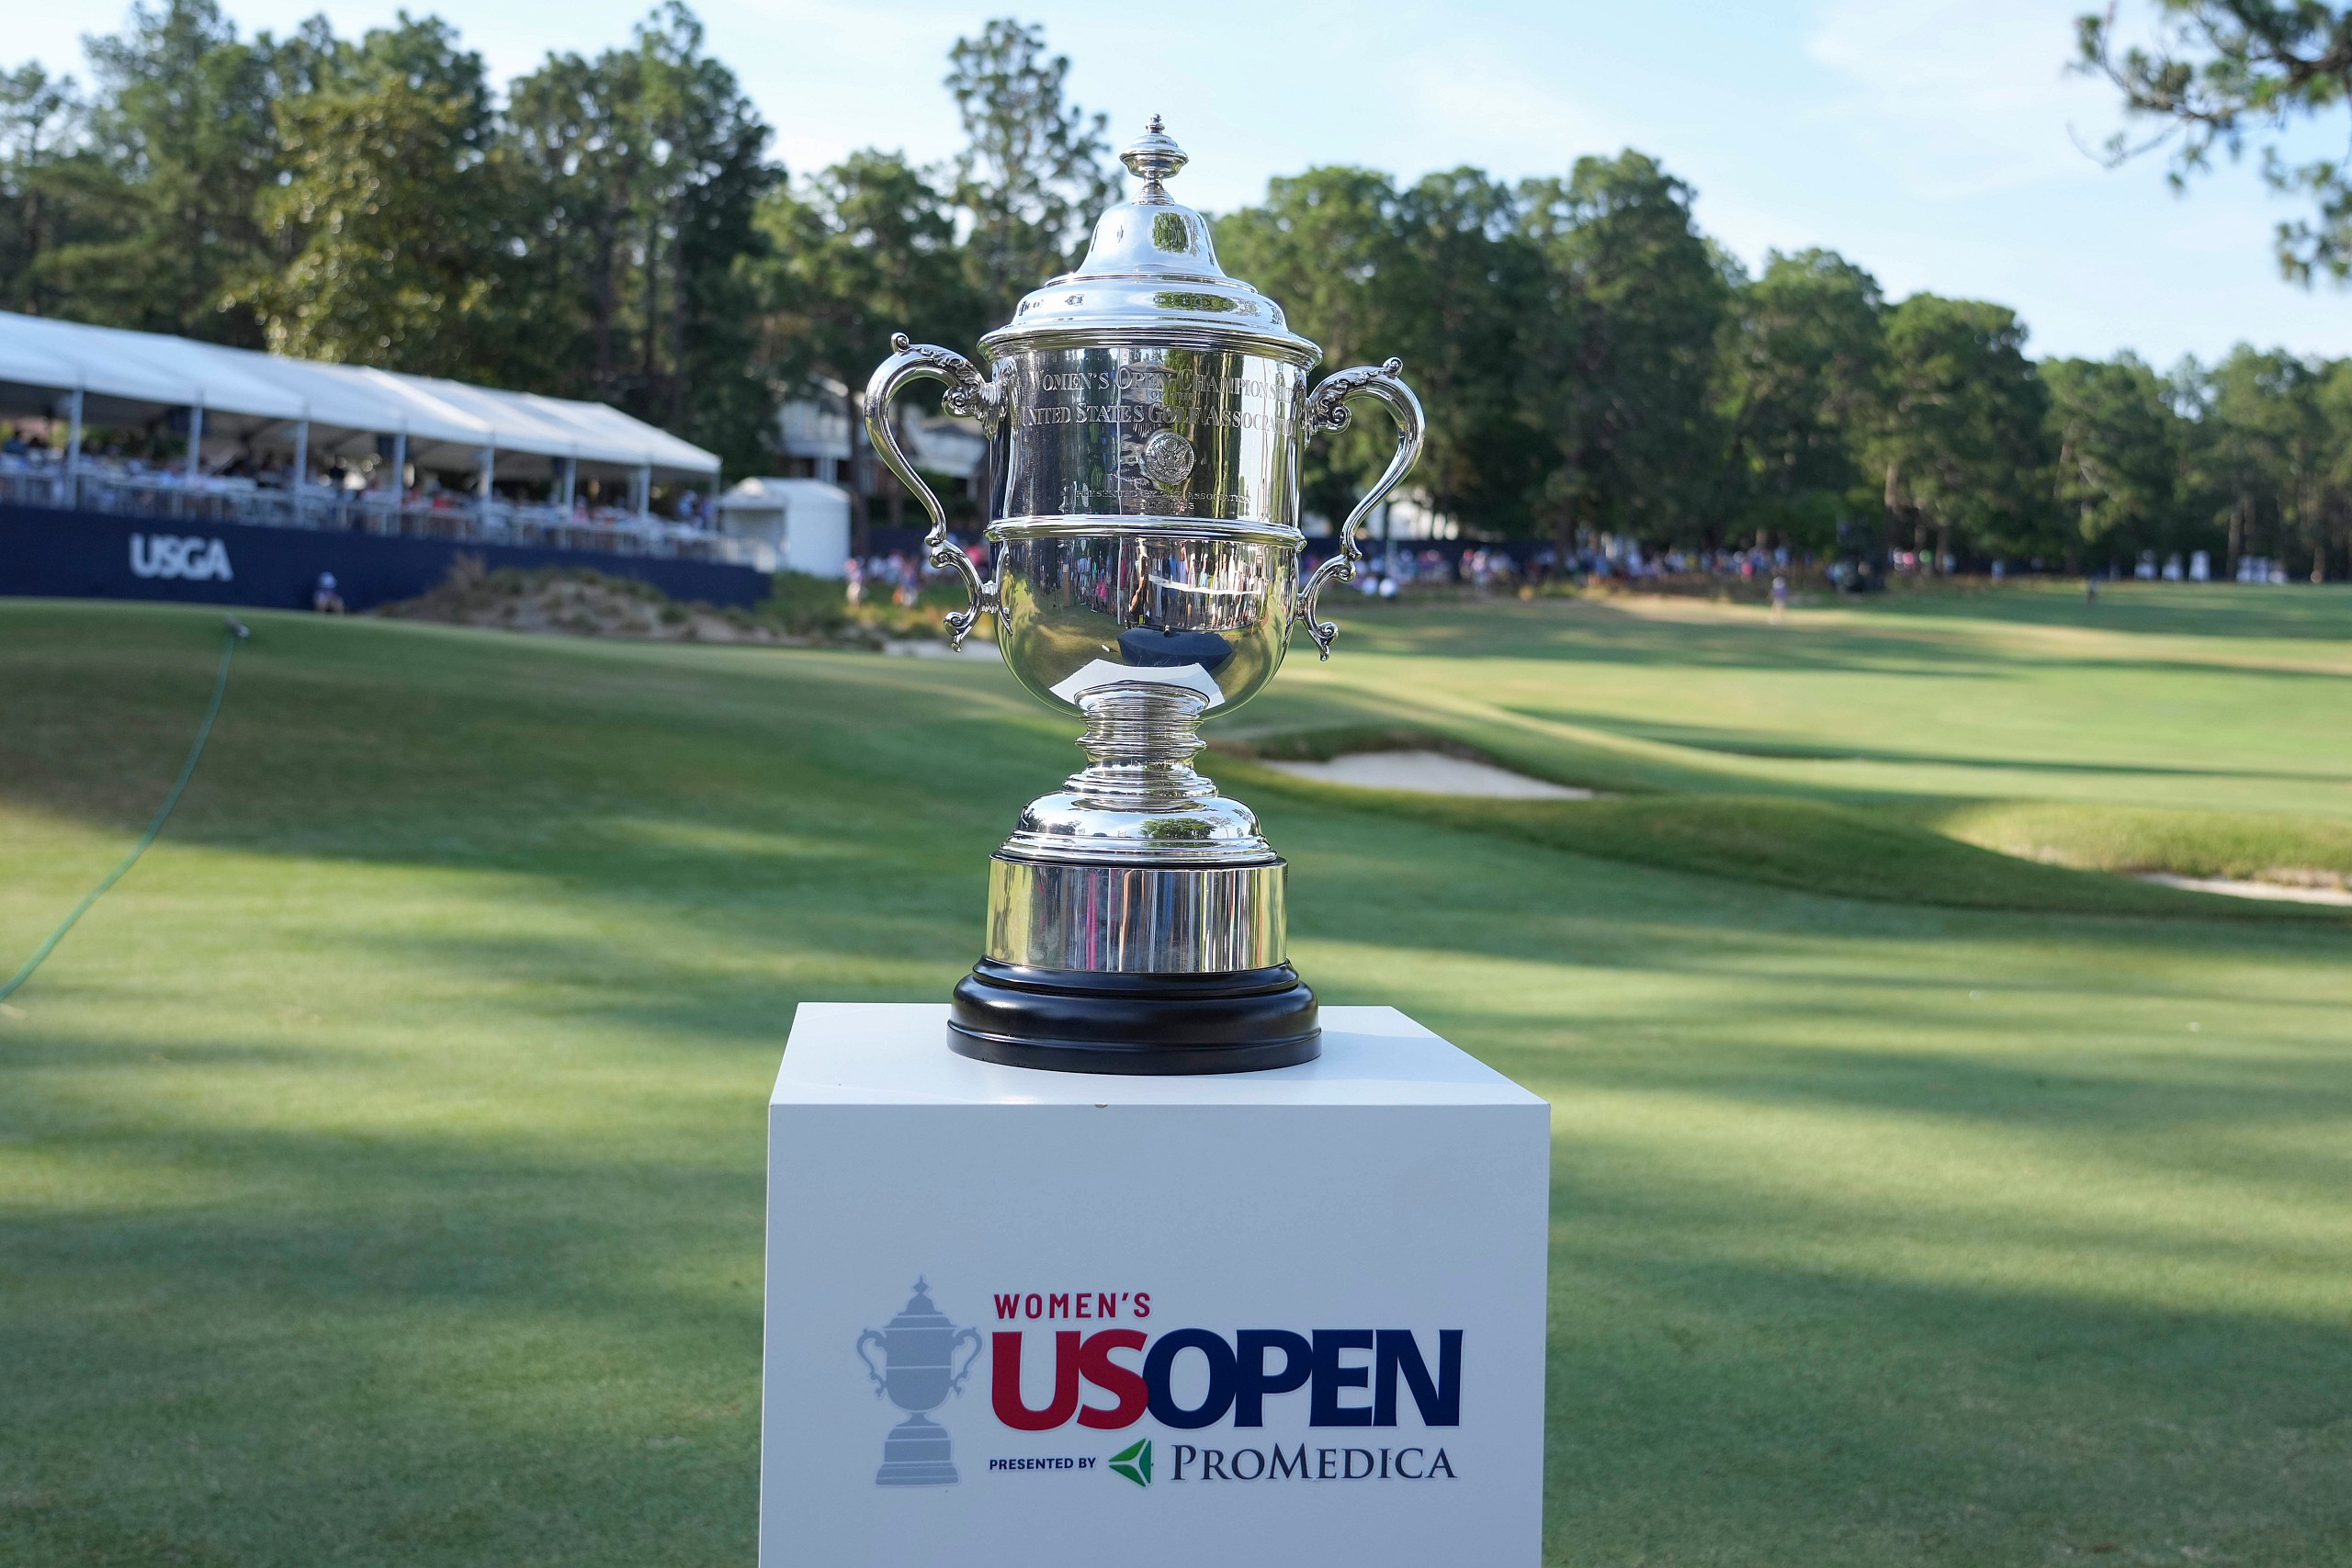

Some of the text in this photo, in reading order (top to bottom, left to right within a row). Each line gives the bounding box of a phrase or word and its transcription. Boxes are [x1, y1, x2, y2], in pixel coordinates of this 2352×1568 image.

[1115, 367, 1173, 389] OPEN
[1177, 368, 1293, 403] CHAMPIONSHIP
[1021, 405, 1071, 426] UNITED
[1076, 402, 1145, 423] STATES
[1148, 402, 1202, 424] GOLF
[1076, 490, 1138, 499] PRESENTED
[130, 533, 233, 581] USGA
[993, 1293, 1152, 1320] WOMEN'S
[989, 1457, 1096, 1472] PRESENTED BY
